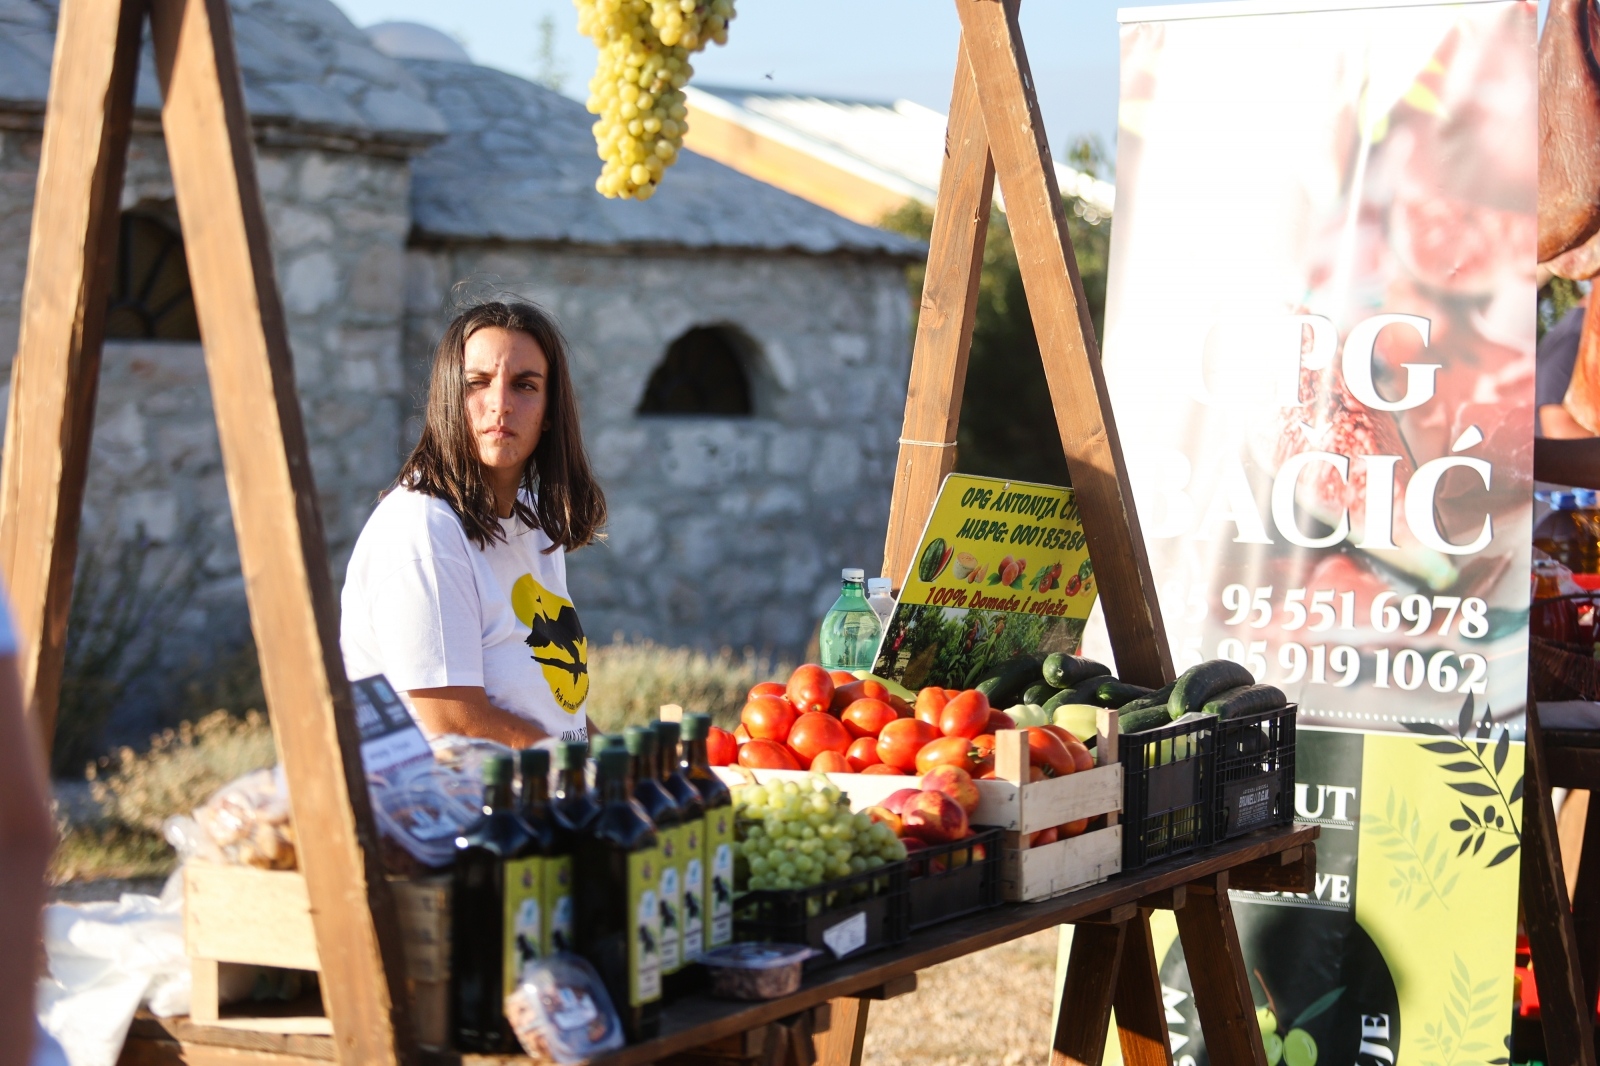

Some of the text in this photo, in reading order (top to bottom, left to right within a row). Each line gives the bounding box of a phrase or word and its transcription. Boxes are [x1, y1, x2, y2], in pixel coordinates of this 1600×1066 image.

[961, 487, 993, 508] OPG
[990, 490, 1060, 522] ANTONIJA
[956, 518, 1009, 544] MIBPG:
[925, 587, 967, 608] 100%
[968, 590, 1018, 612] Domaće
[1221, 584, 1273, 629] 95
[1283, 587, 1357, 632] 551
[1370, 591, 1490, 639] 6978
[1278, 642, 1361, 688] 919
[1373, 648, 1490, 695] 1062
